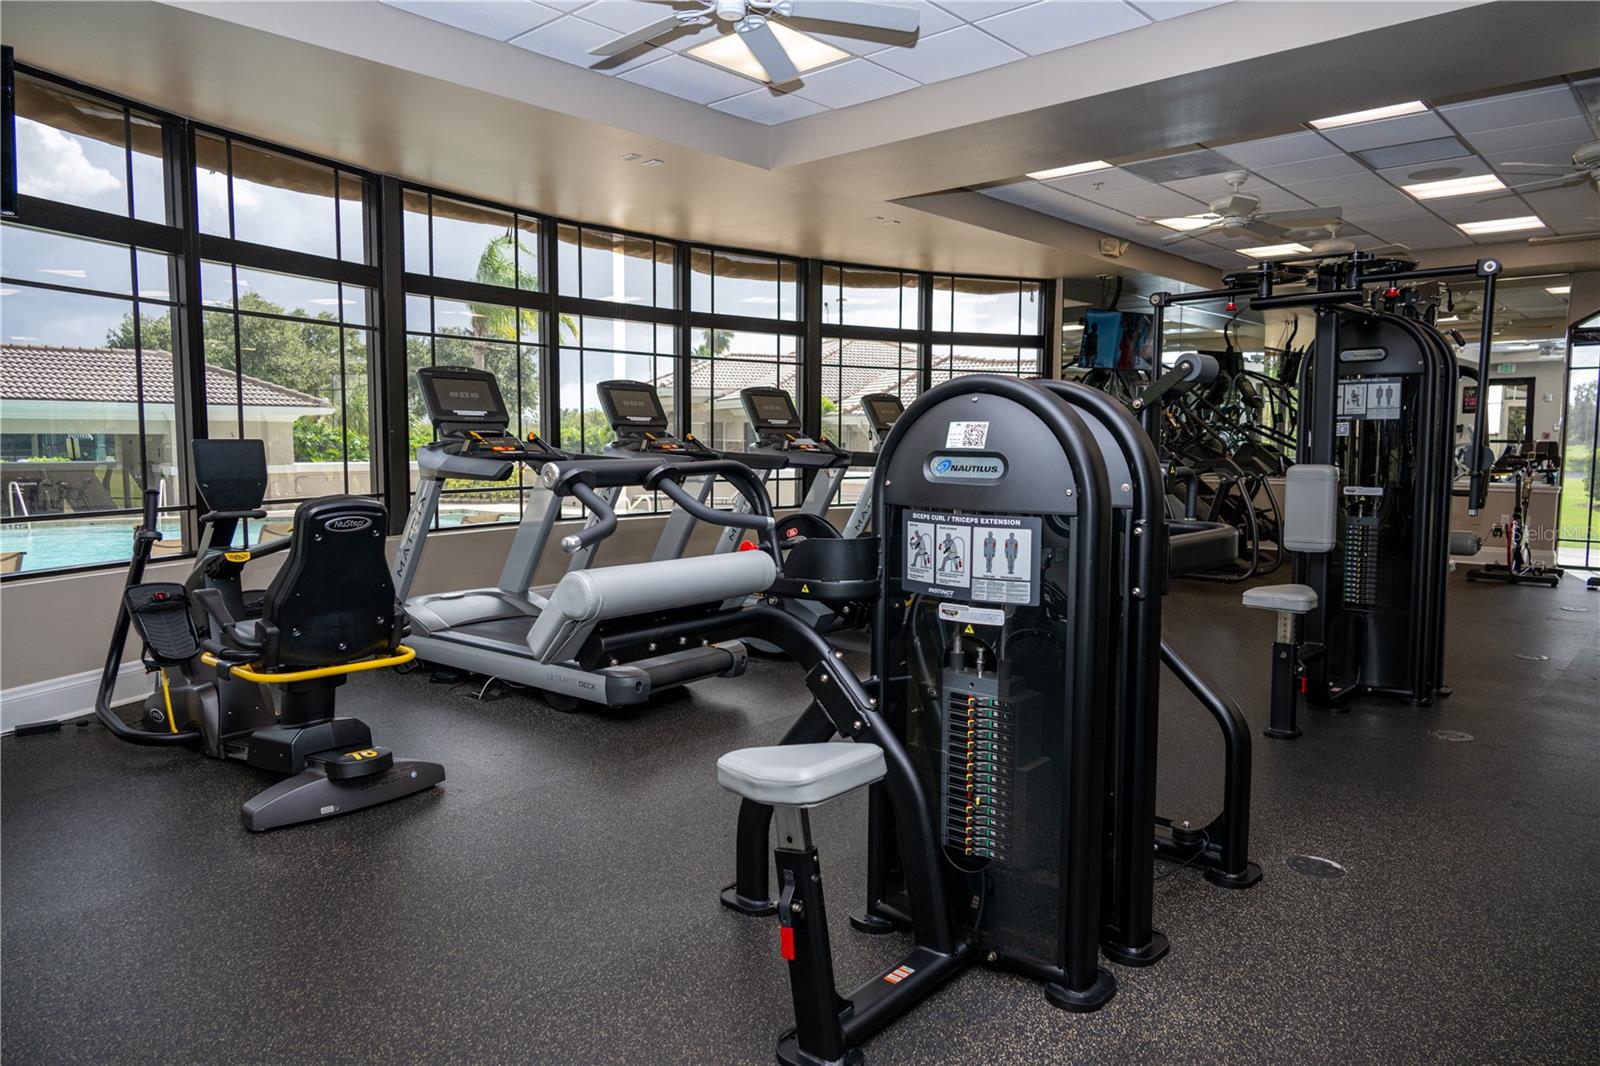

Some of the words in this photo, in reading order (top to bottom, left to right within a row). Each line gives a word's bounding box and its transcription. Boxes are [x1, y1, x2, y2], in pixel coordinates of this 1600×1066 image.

[951, 464, 998, 473] NAUTILUS
[912, 512, 931, 521] BICEPS
[931, 514, 946, 522] CURL
[951, 516, 979, 524] TRICEPS
[980, 517, 1021, 526] EXTENSION
[578, 680, 597, 691] DECK
